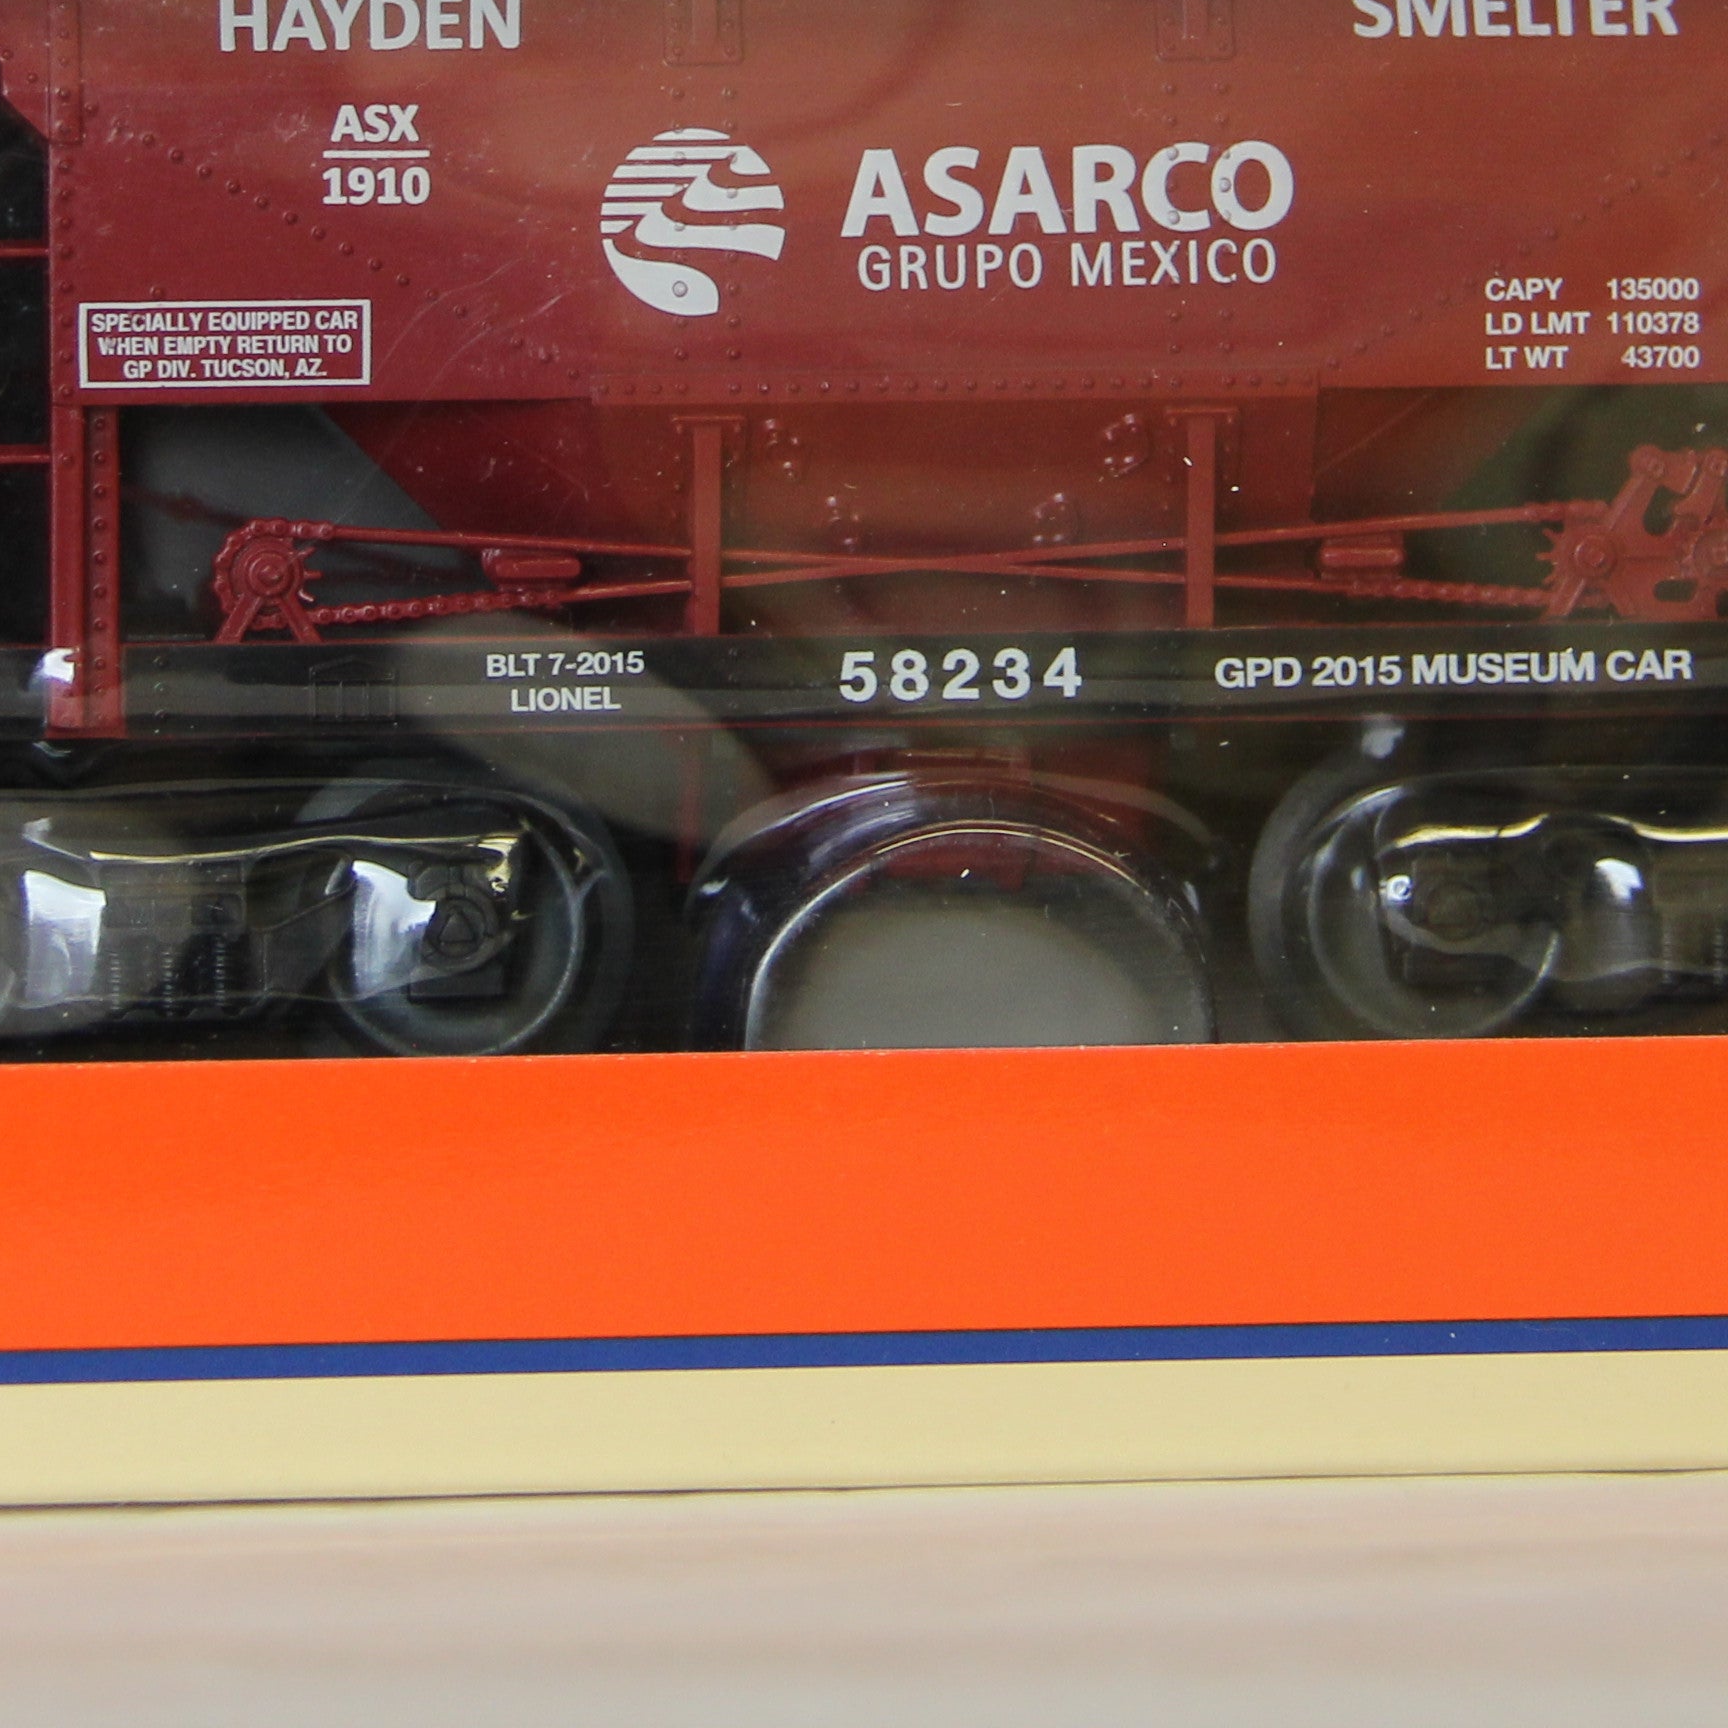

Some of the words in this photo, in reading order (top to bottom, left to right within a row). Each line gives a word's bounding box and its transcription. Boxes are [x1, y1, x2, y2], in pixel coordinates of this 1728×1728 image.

[330, 104, 420, 143] ASX
[322, 166, 431, 205] 1910
[840, 140, 1294, 236] ASARCO
[857, 242, 1043, 291] GRUPO
[1071, 237, 1277, 287] MEXICO
[1484, 277, 1563, 302] CAPY
[1606, 277, 1701, 301] 135000
[90, 312, 203, 333] SPECIALLY
[207, 310, 311, 332] EQUIPPED
[314, 309, 359, 331] CAR
[1484, 312, 1523, 335] LD
[1530, 311, 1591, 335] LMT
[1606, 311, 1701, 335] 110378
[97, 336, 160, 356] WHEN
[163, 335, 233, 355] EMPTY
[236, 334, 320, 355] RETURN
[323, 333, 353, 354] TO
[1484, 346, 1518, 370] LT
[1524, 345, 1569, 369] WT
[1621, 345, 1701, 369] 43700
[123, 359, 153, 379] GP
[157, 359, 197, 379] DIV.
[199, 358, 290, 380] TUCSON,
[294, 357, 328, 377] AZ.
[485, 653, 542, 678] BLT
[547, 651, 645, 676] 7-2015
[838, 647, 1083, 703] 58234
[1214, 657, 1303, 689] GPD
[1311, 655, 1402, 687] 2015
[1411, 650, 1596, 686] MUSEUM
[1605, 649, 1693, 683] CAR
[510, 686, 622, 713] LIONEL
